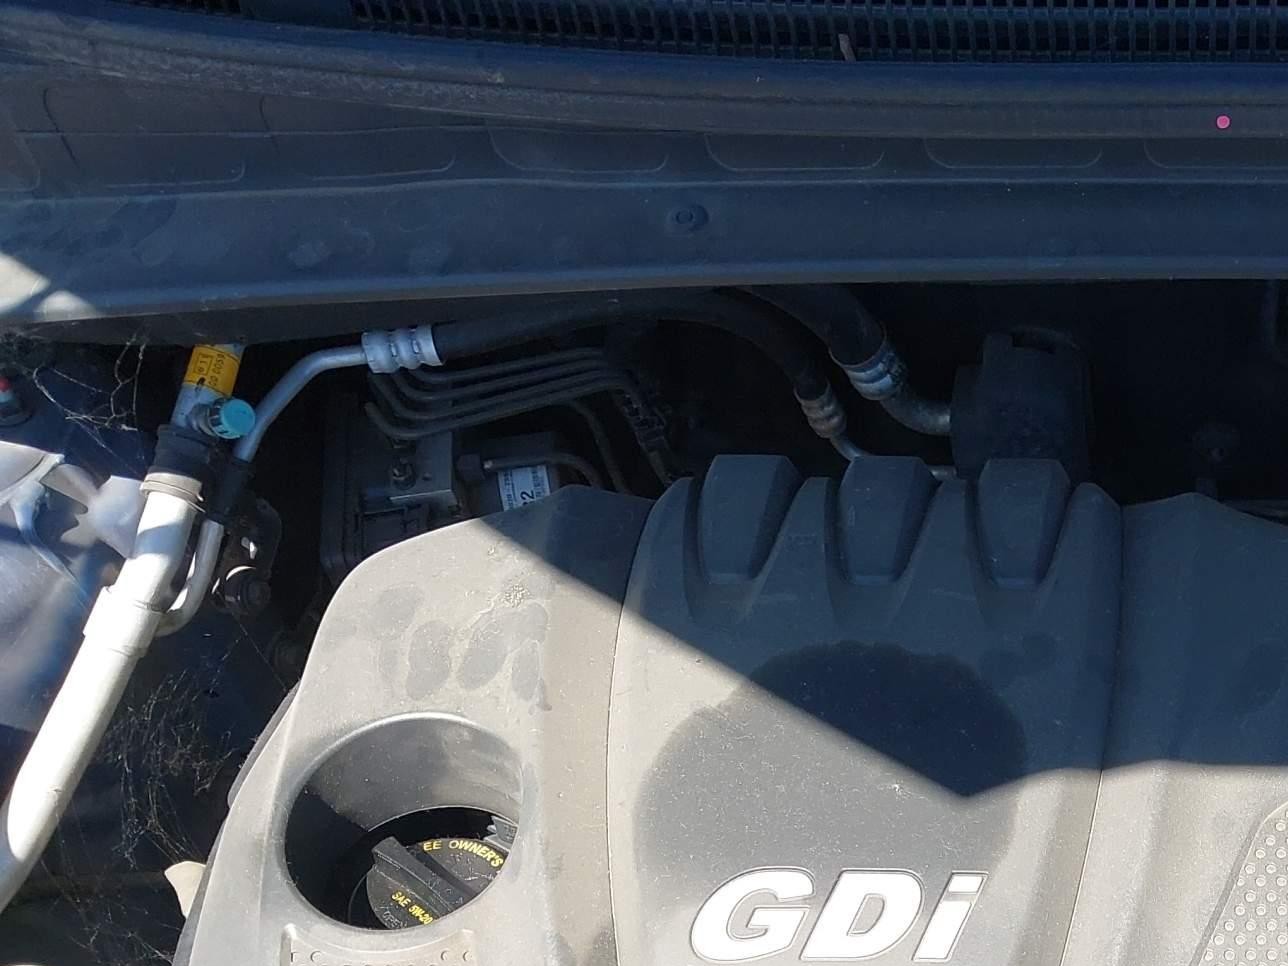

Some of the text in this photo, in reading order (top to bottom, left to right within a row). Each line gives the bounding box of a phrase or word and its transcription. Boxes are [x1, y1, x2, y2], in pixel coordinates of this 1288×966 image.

[423, 840, 504, 868] EE OWNER'S
[391, 891, 411, 908] SAE
[690, 866, 989, 963] GDi
